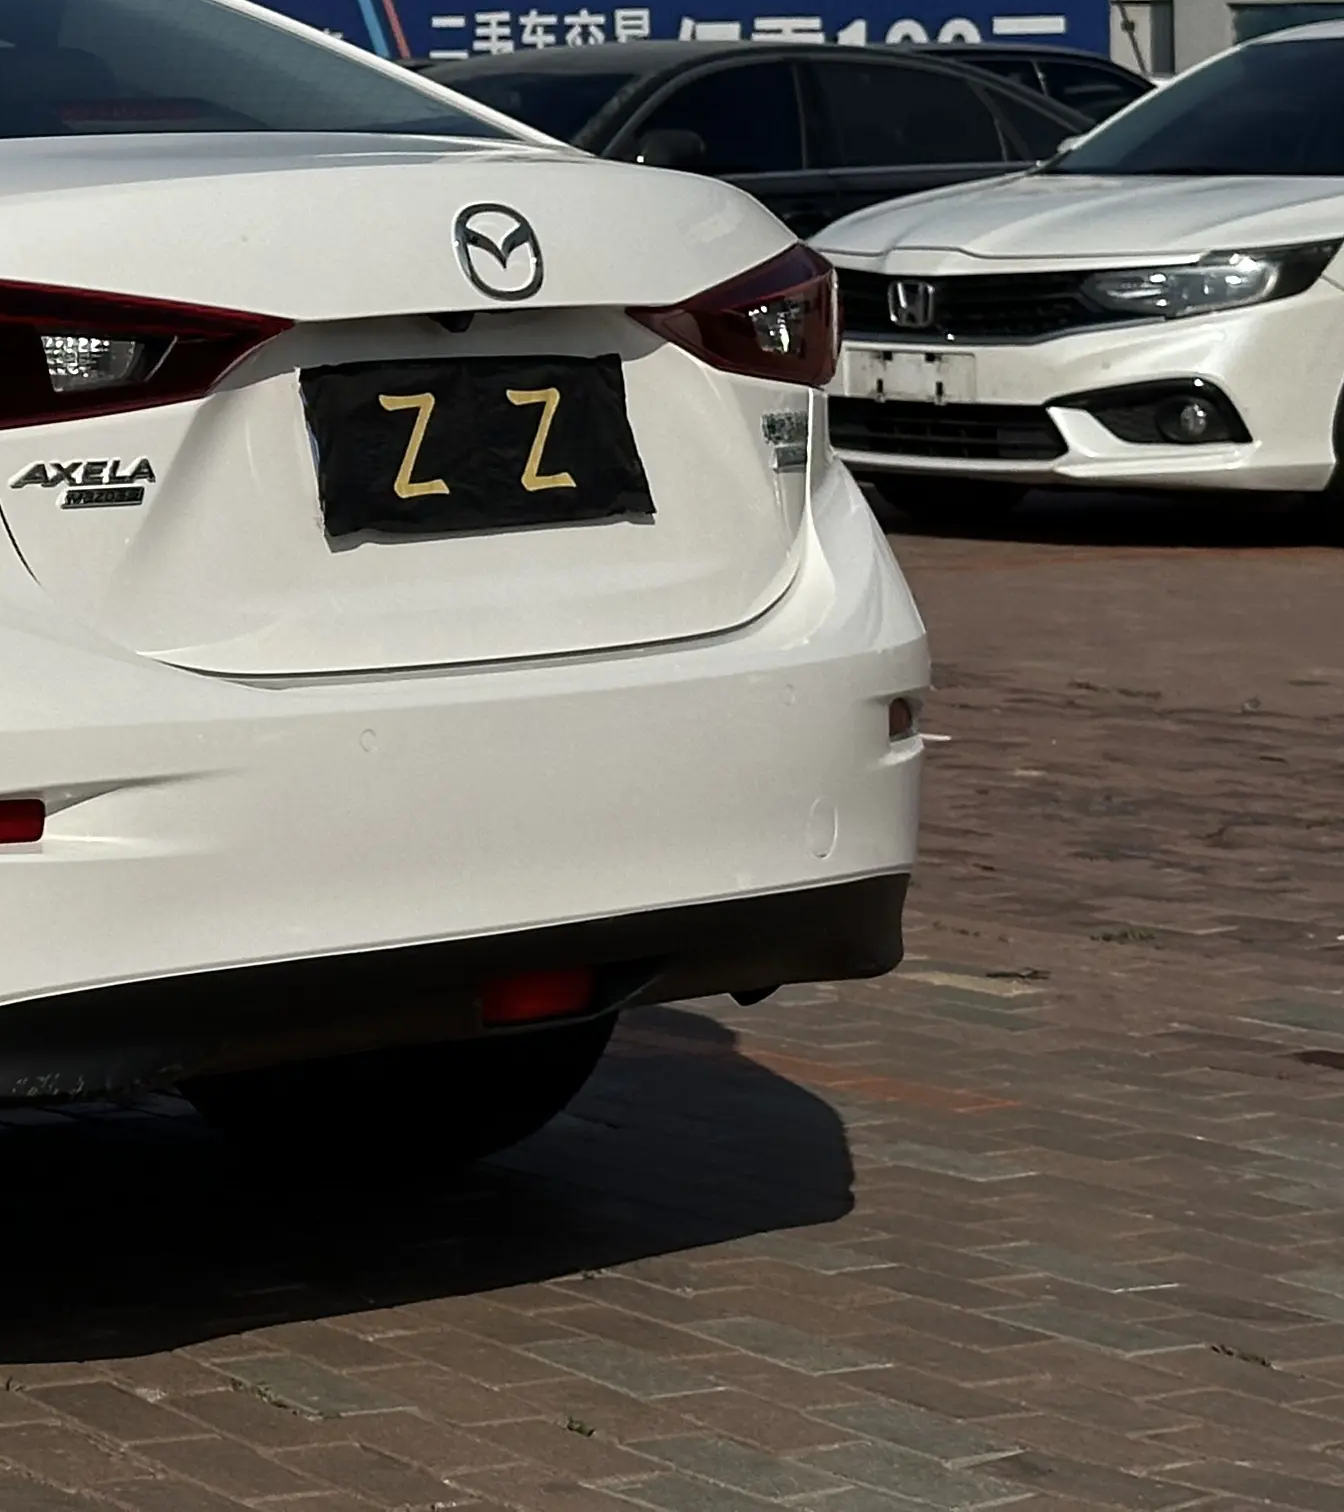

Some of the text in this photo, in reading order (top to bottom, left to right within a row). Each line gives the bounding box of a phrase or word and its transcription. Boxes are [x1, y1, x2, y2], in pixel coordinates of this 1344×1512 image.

[9, 456, 156, 489] AXELA
[378, 387, 577, 498] Z Z
